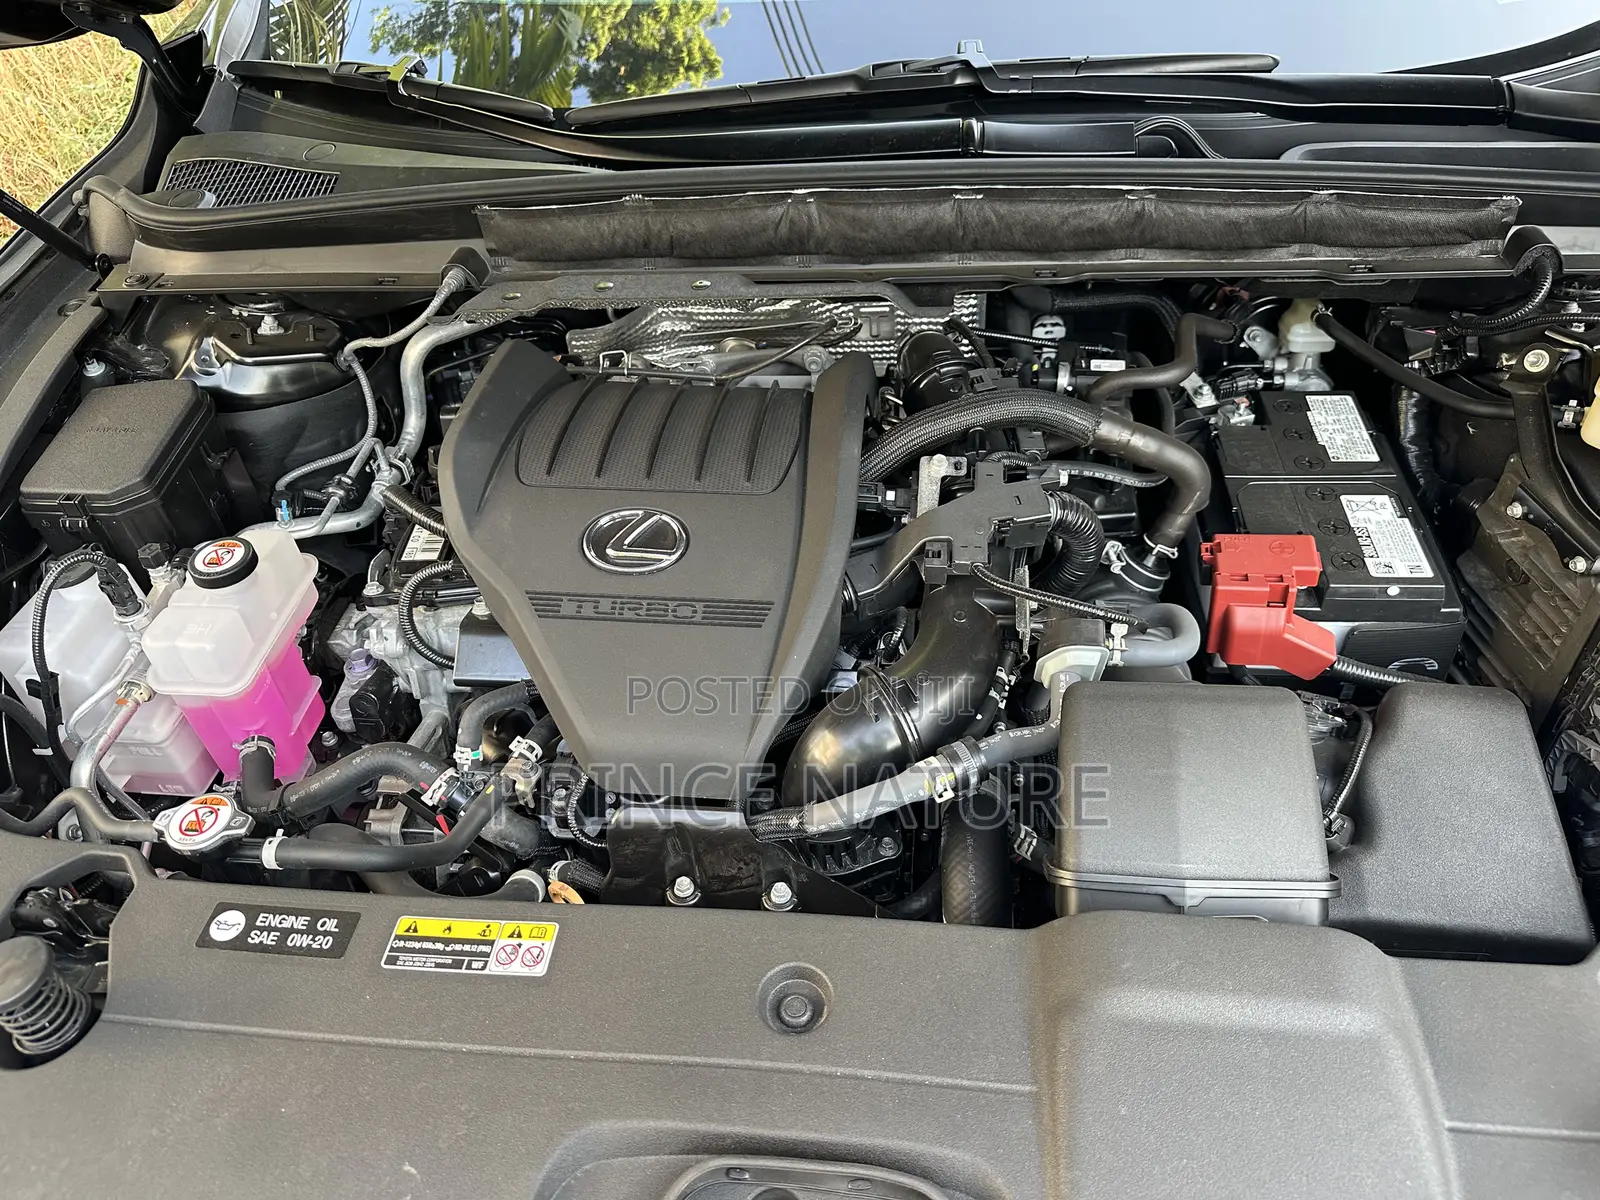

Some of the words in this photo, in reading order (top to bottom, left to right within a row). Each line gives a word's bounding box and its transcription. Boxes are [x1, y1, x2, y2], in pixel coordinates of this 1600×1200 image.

[561, 597, 699, 621] TURBO
[255, 912, 311, 931] ENGINE
[317, 916, 340, 932] OIL
[247, 930, 279, 946] SAE
[287, 933, 333, 949] 0W-20
